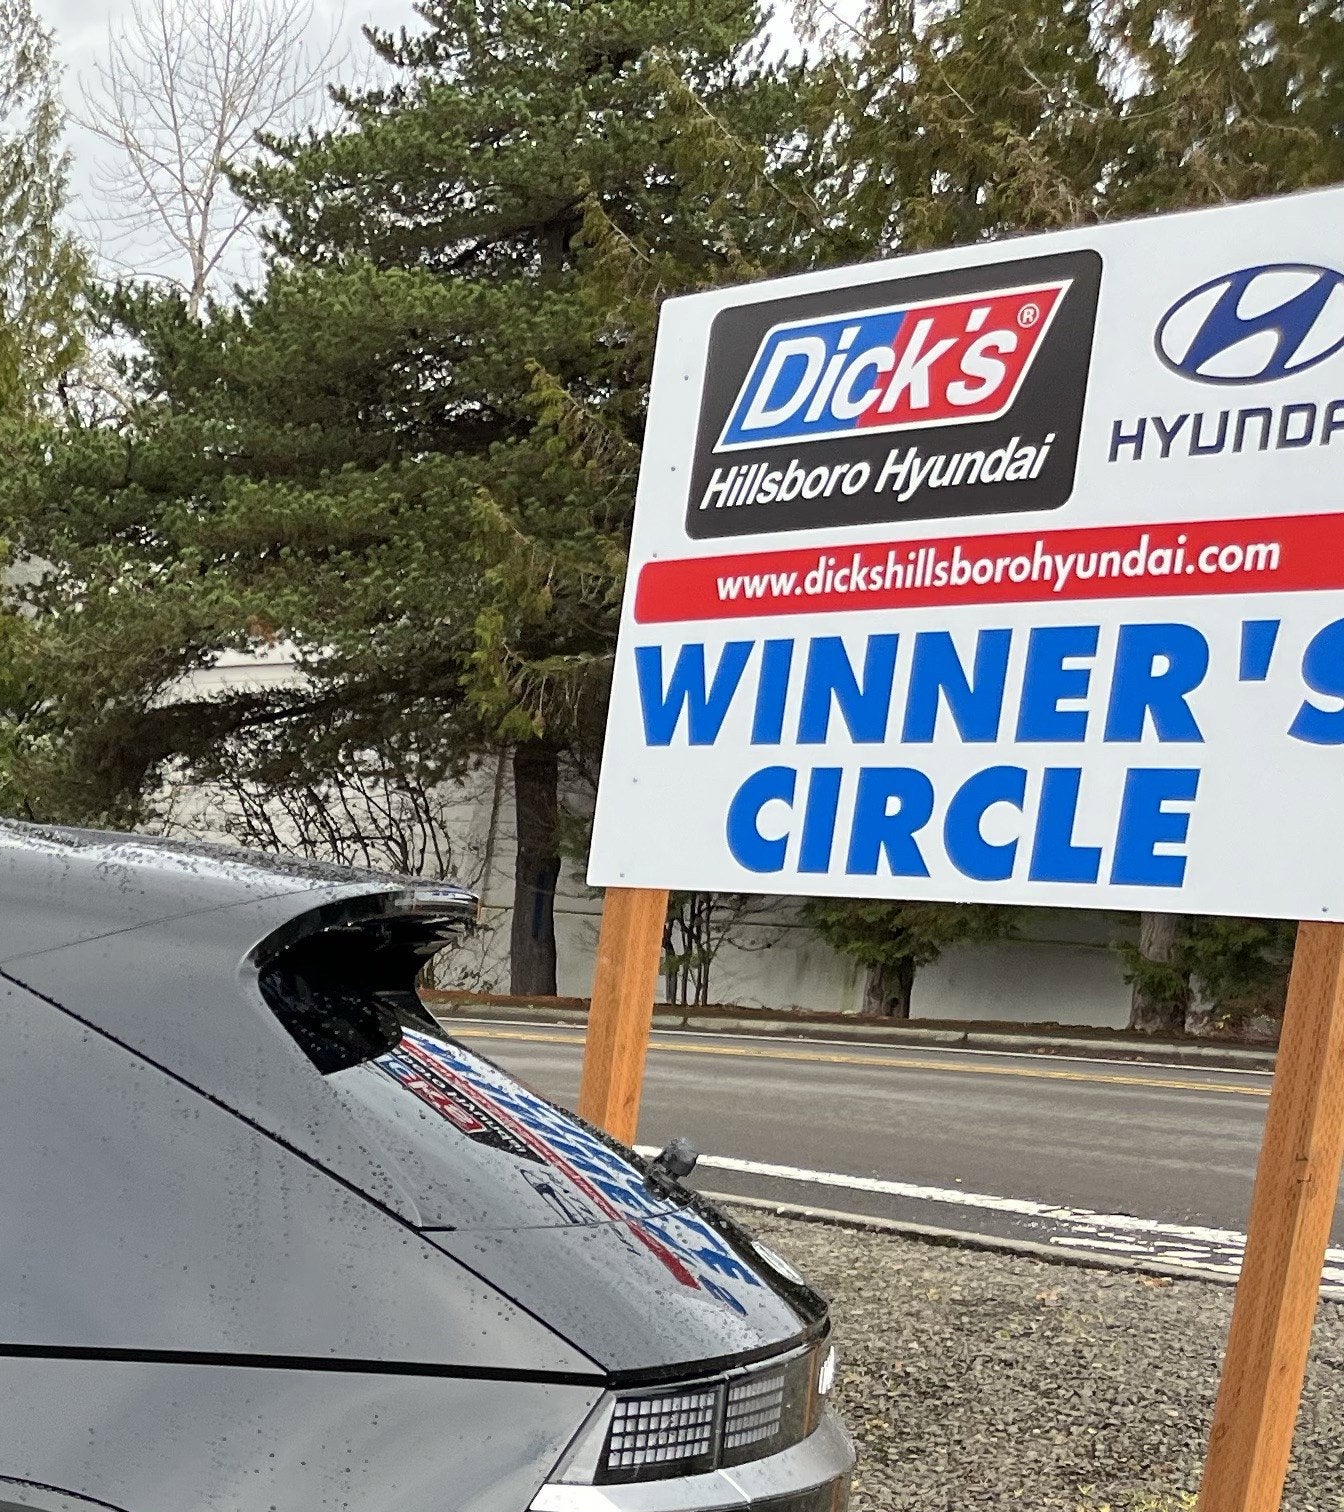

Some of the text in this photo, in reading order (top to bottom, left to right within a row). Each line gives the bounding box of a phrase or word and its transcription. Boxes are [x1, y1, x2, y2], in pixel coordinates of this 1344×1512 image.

[698, 432, 1056, 510] Hillsboro Hyundai
[716, 534, 1281, 601] www.dickshillsborohyundai.com
[635, 619, 1344, 747] WINNER'S
[726, 765, 1201, 888] CIRCLE
